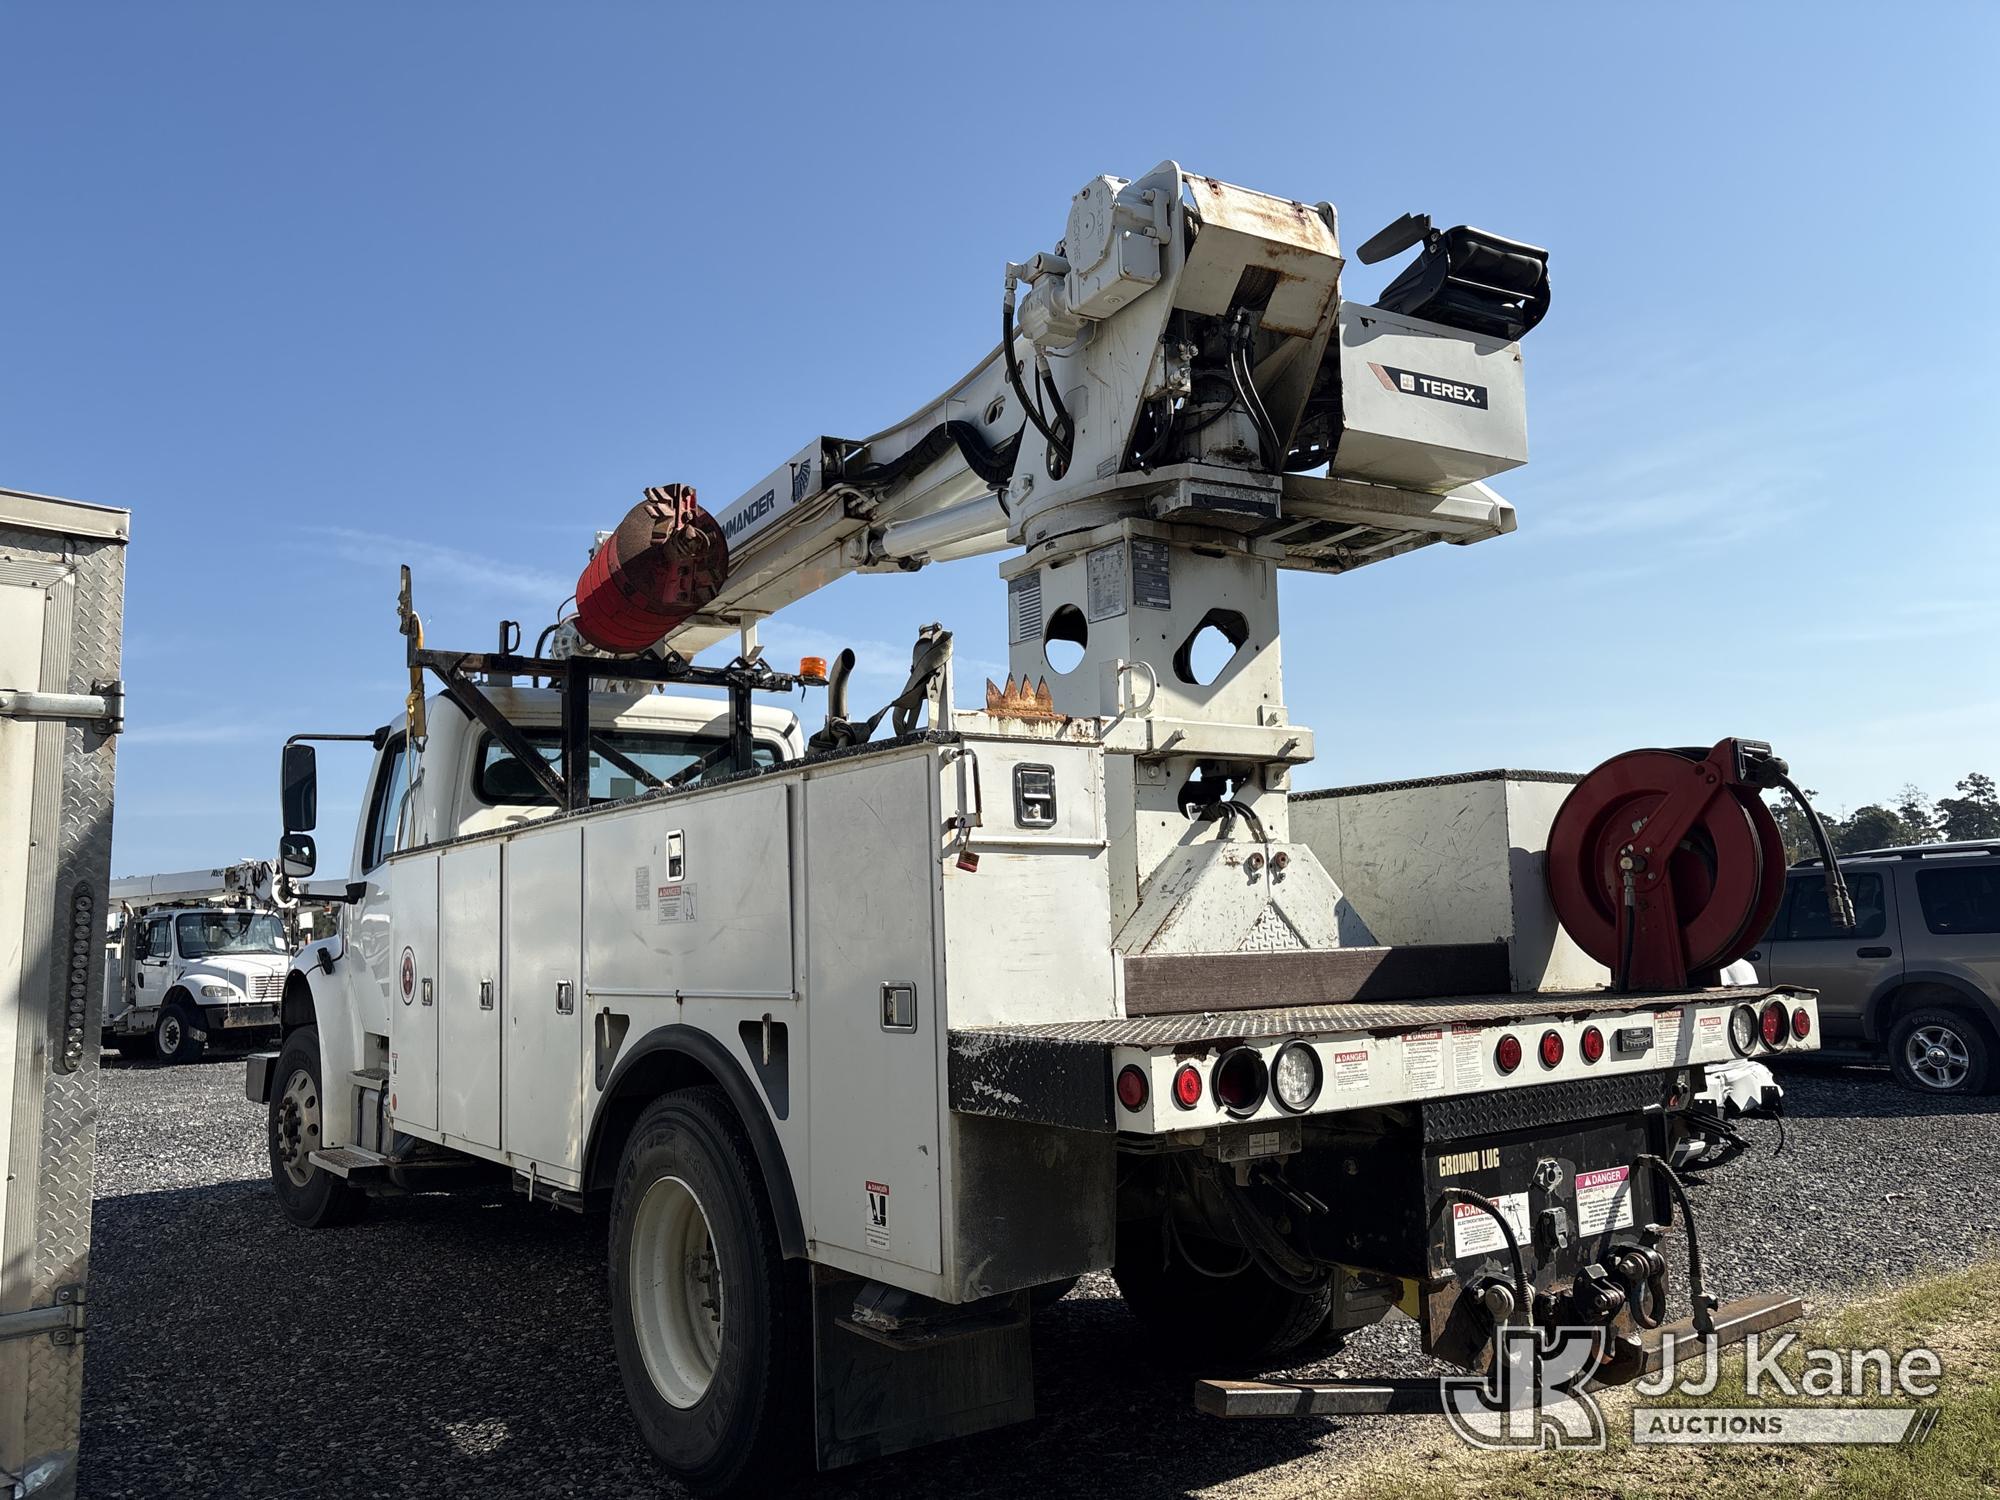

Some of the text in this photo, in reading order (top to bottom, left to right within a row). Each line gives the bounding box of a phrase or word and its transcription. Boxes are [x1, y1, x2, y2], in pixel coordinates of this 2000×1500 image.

[1419, 378, 1476, 403] TEREX
[1412, 1031, 1438, 1041] DANGER
[1342, 1052, 1367, 1063] DANGER
[1438, 1147, 1501, 1177] GROUND LUG
[1592, 1170, 1621, 1185] DANGER
